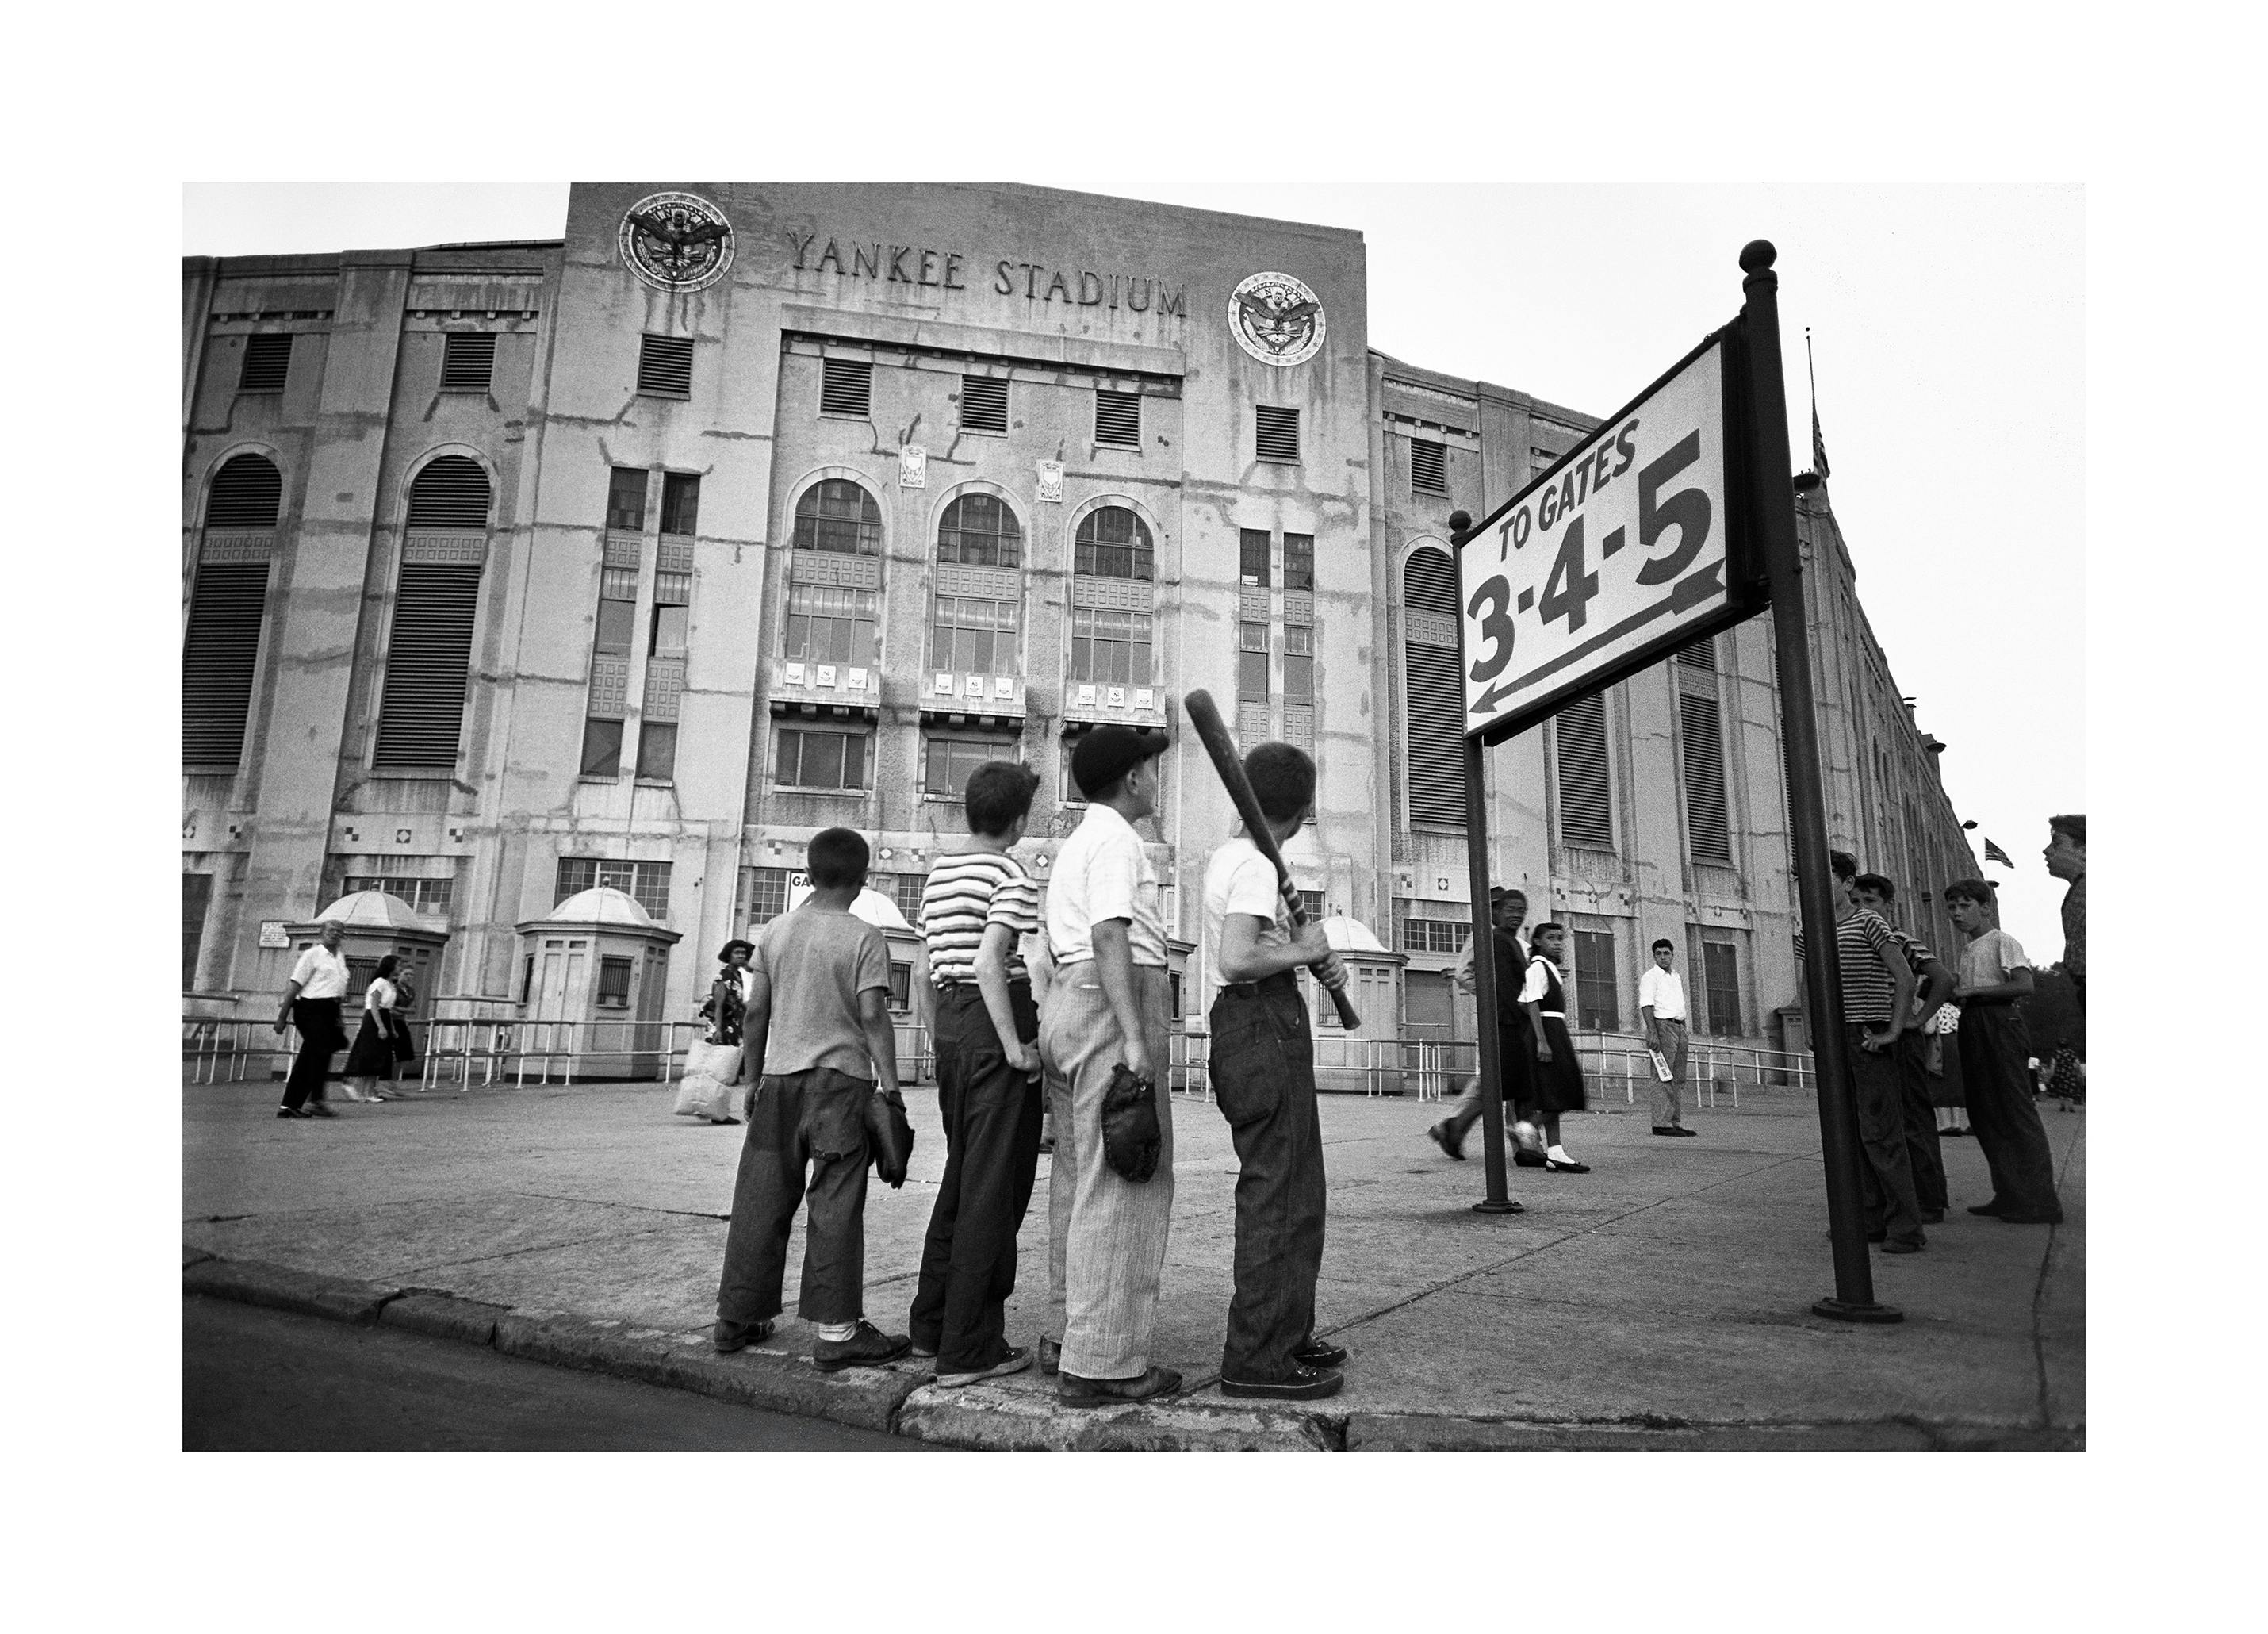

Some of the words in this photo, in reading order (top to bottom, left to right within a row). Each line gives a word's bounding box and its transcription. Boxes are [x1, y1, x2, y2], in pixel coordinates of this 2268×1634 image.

[787, 233, 964, 290] YANKEE
[994, 260, 1186, 318] STADIUM
[1499, 505, 1531, 562] TO
[1538, 418, 1640, 531] GATES
[1467, 428, 1712, 684] 3-4-5
[792, 876, 810, 887] GA
